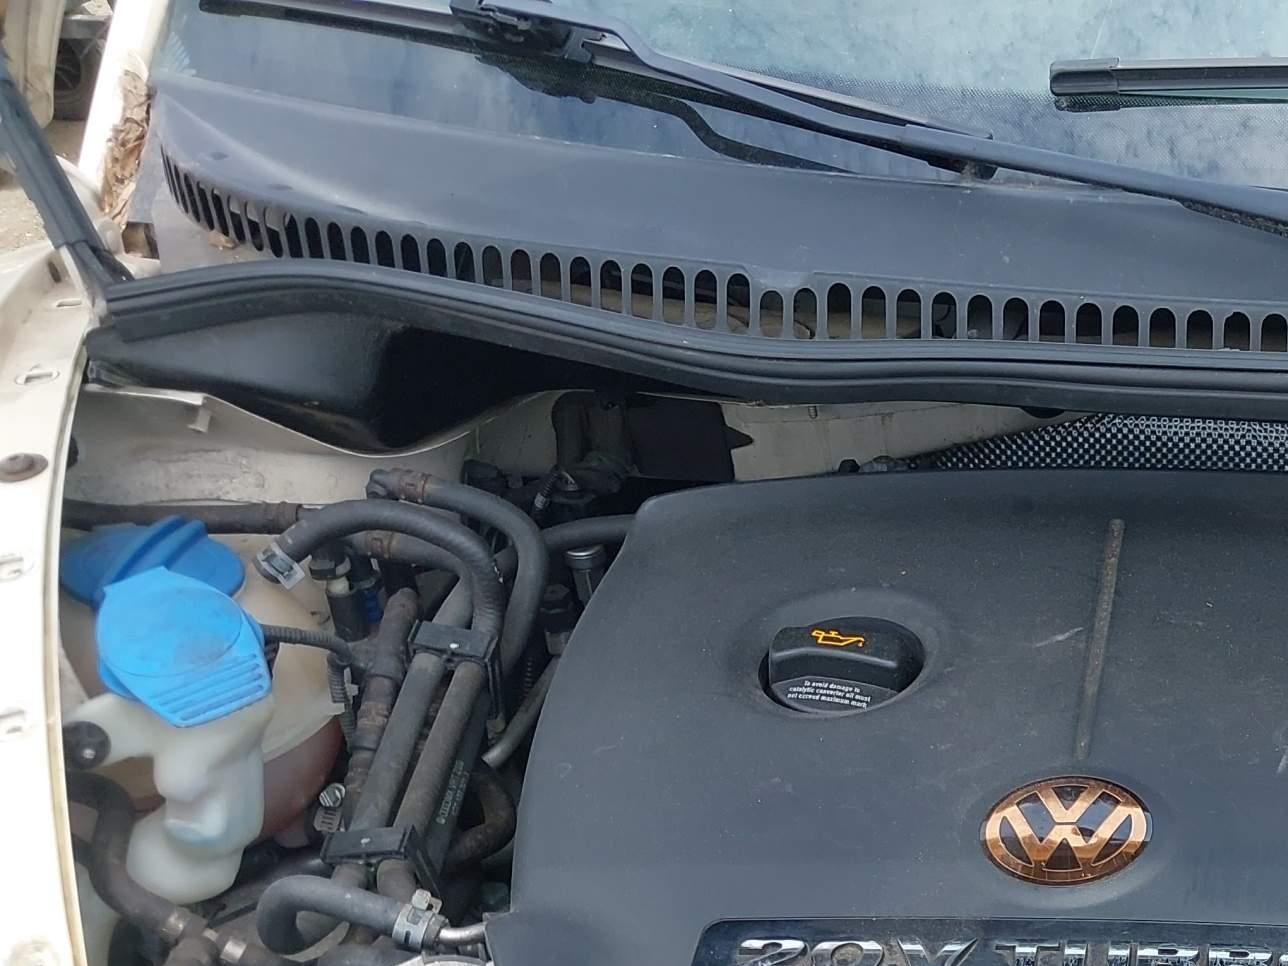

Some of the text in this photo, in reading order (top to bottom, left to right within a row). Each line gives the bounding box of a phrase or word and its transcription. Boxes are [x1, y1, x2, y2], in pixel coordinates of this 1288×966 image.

[829, 683, 853, 692] damage
[816, 688, 845, 697] converter
[855, 694, 871, 703] must
[820, 695, 849, 704] maximum
